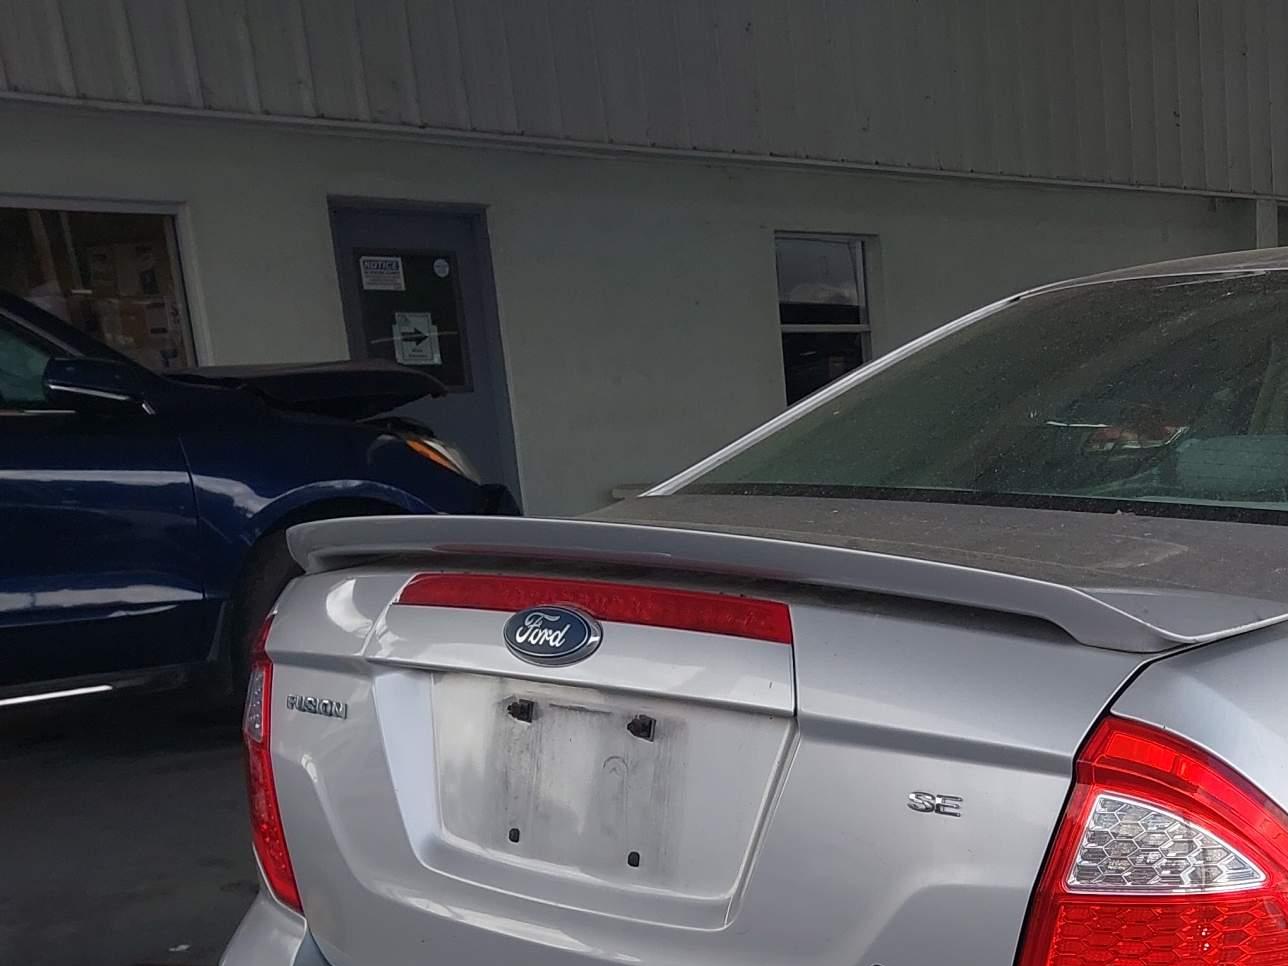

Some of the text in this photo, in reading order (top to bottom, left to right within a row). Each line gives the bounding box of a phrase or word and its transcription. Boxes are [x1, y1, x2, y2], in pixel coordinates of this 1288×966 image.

[363, 260, 400, 271] NOTICE
[516, 612, 571, 647] Ford
[286, 695, 348, 720] FUSION
[907, 791, 964, 817] SE
